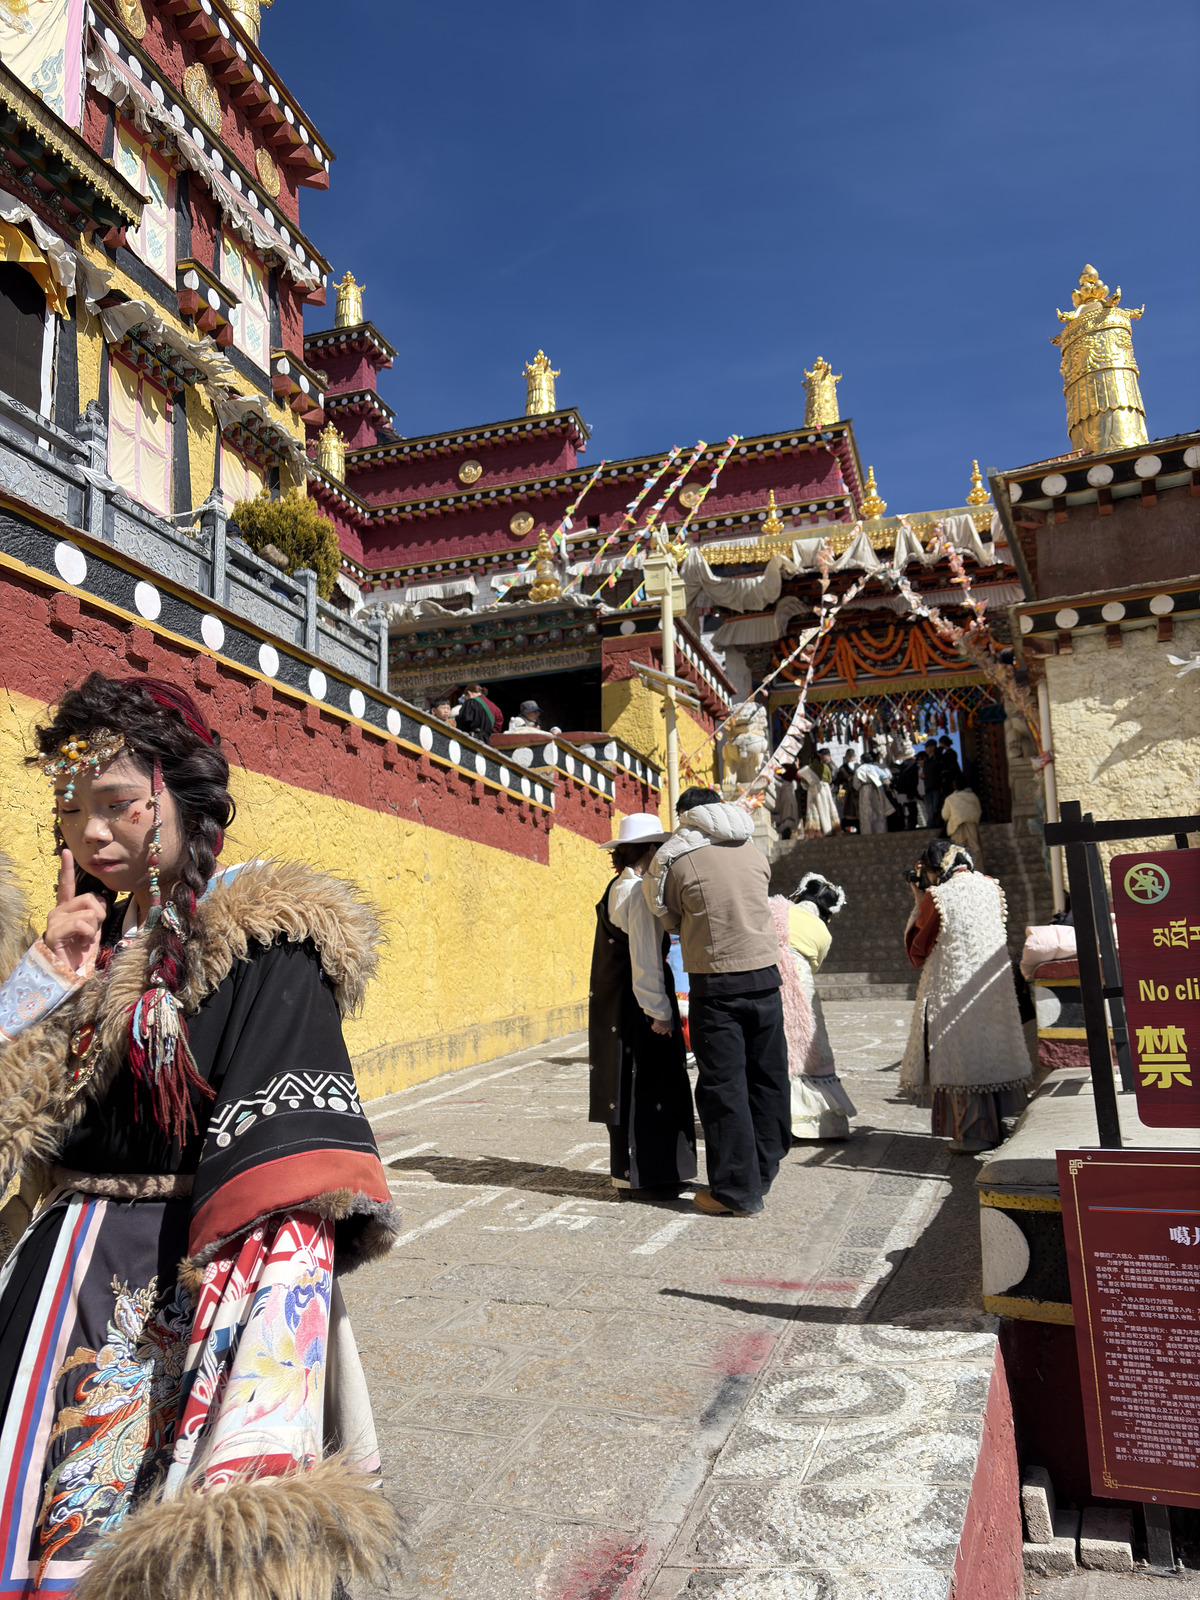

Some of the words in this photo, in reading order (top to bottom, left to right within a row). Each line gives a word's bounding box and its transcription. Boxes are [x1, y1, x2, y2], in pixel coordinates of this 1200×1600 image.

[1139, 979, 1169, 1001] No
[1135, 1025, 1192, 1088] 禁
[1103, 1331, 1200, 1343] 为宗教圣地和文保单位，全域严禁吸
